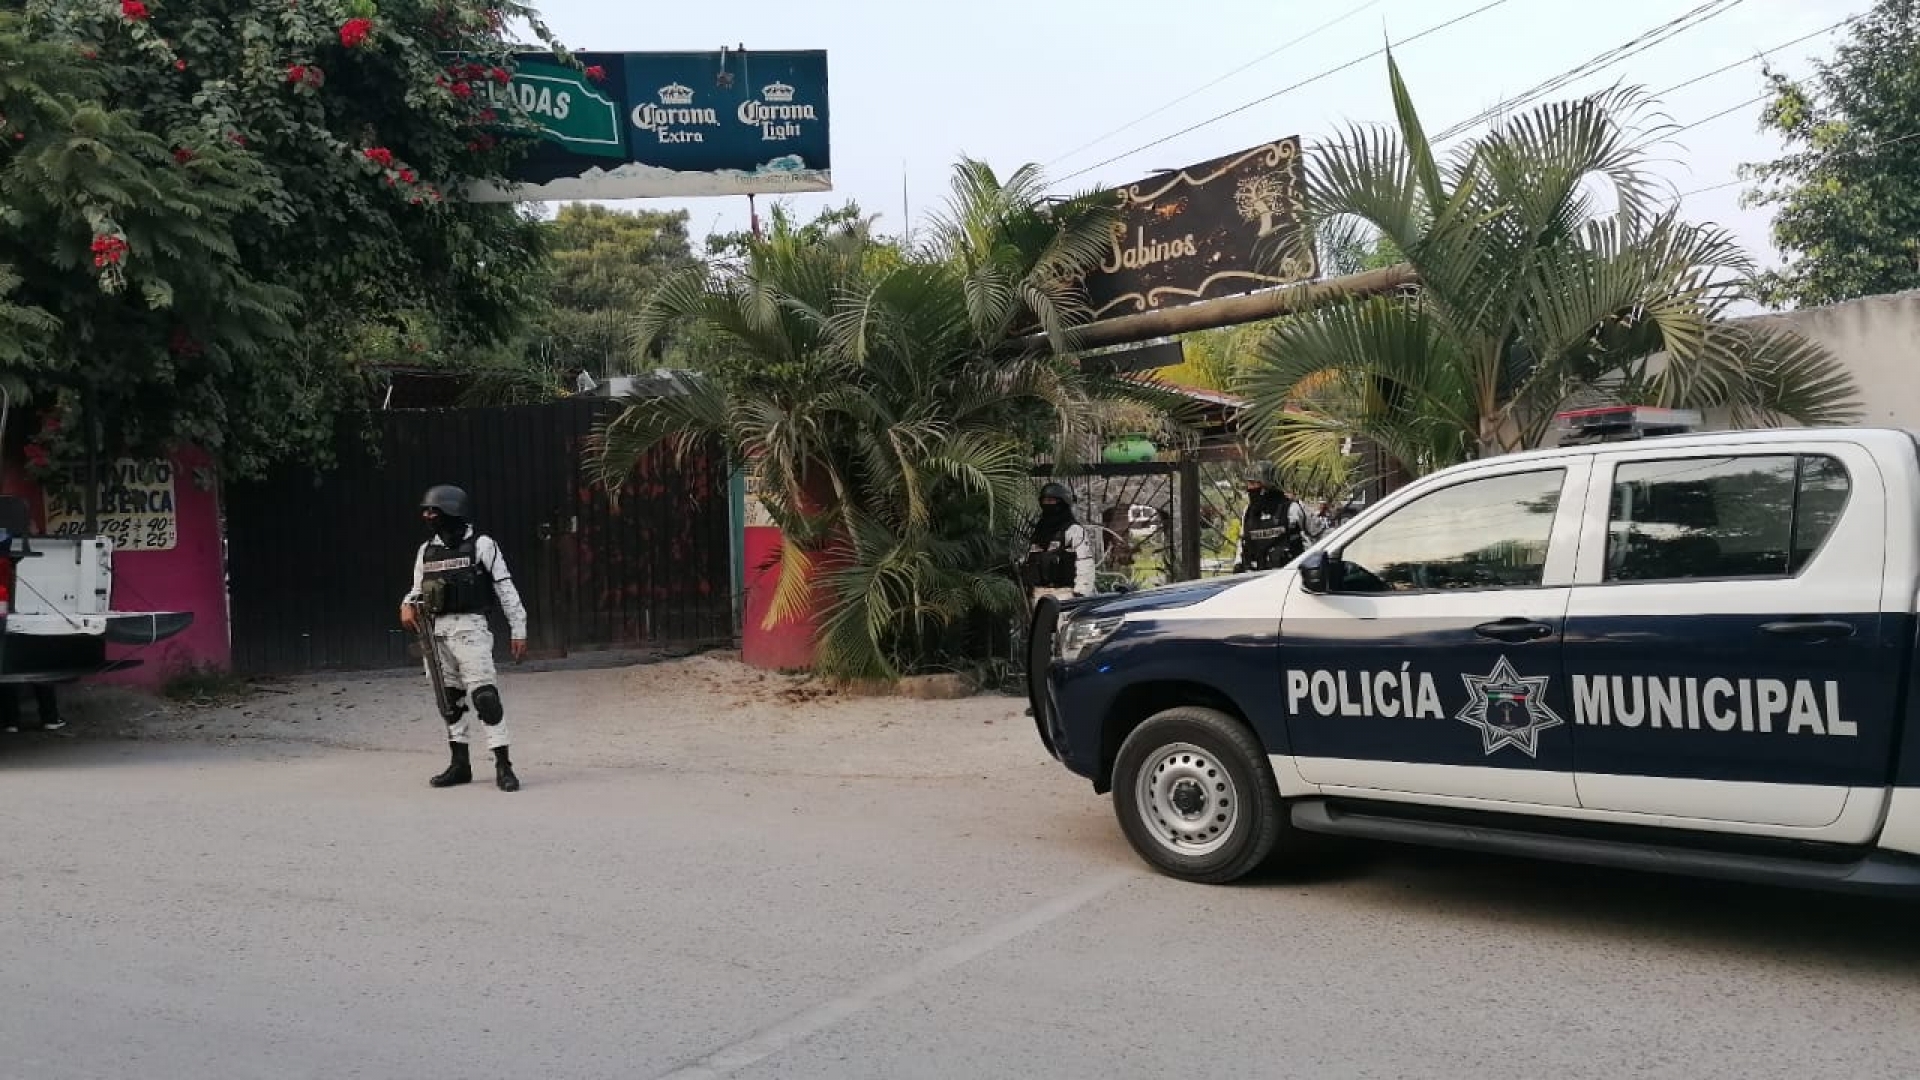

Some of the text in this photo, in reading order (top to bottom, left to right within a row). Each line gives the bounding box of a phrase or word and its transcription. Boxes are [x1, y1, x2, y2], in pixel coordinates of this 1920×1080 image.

[632, 102, 720, 131] Corona
[738, 100, 817, 126] Corona
[658, 125, 704, 143] Extra
[761, 122, 801, 140] Light
[1100, 221, 1197, 274] Sabinos
[1286, 661, 1858, 737] POLICÍA MUNICIPAL
